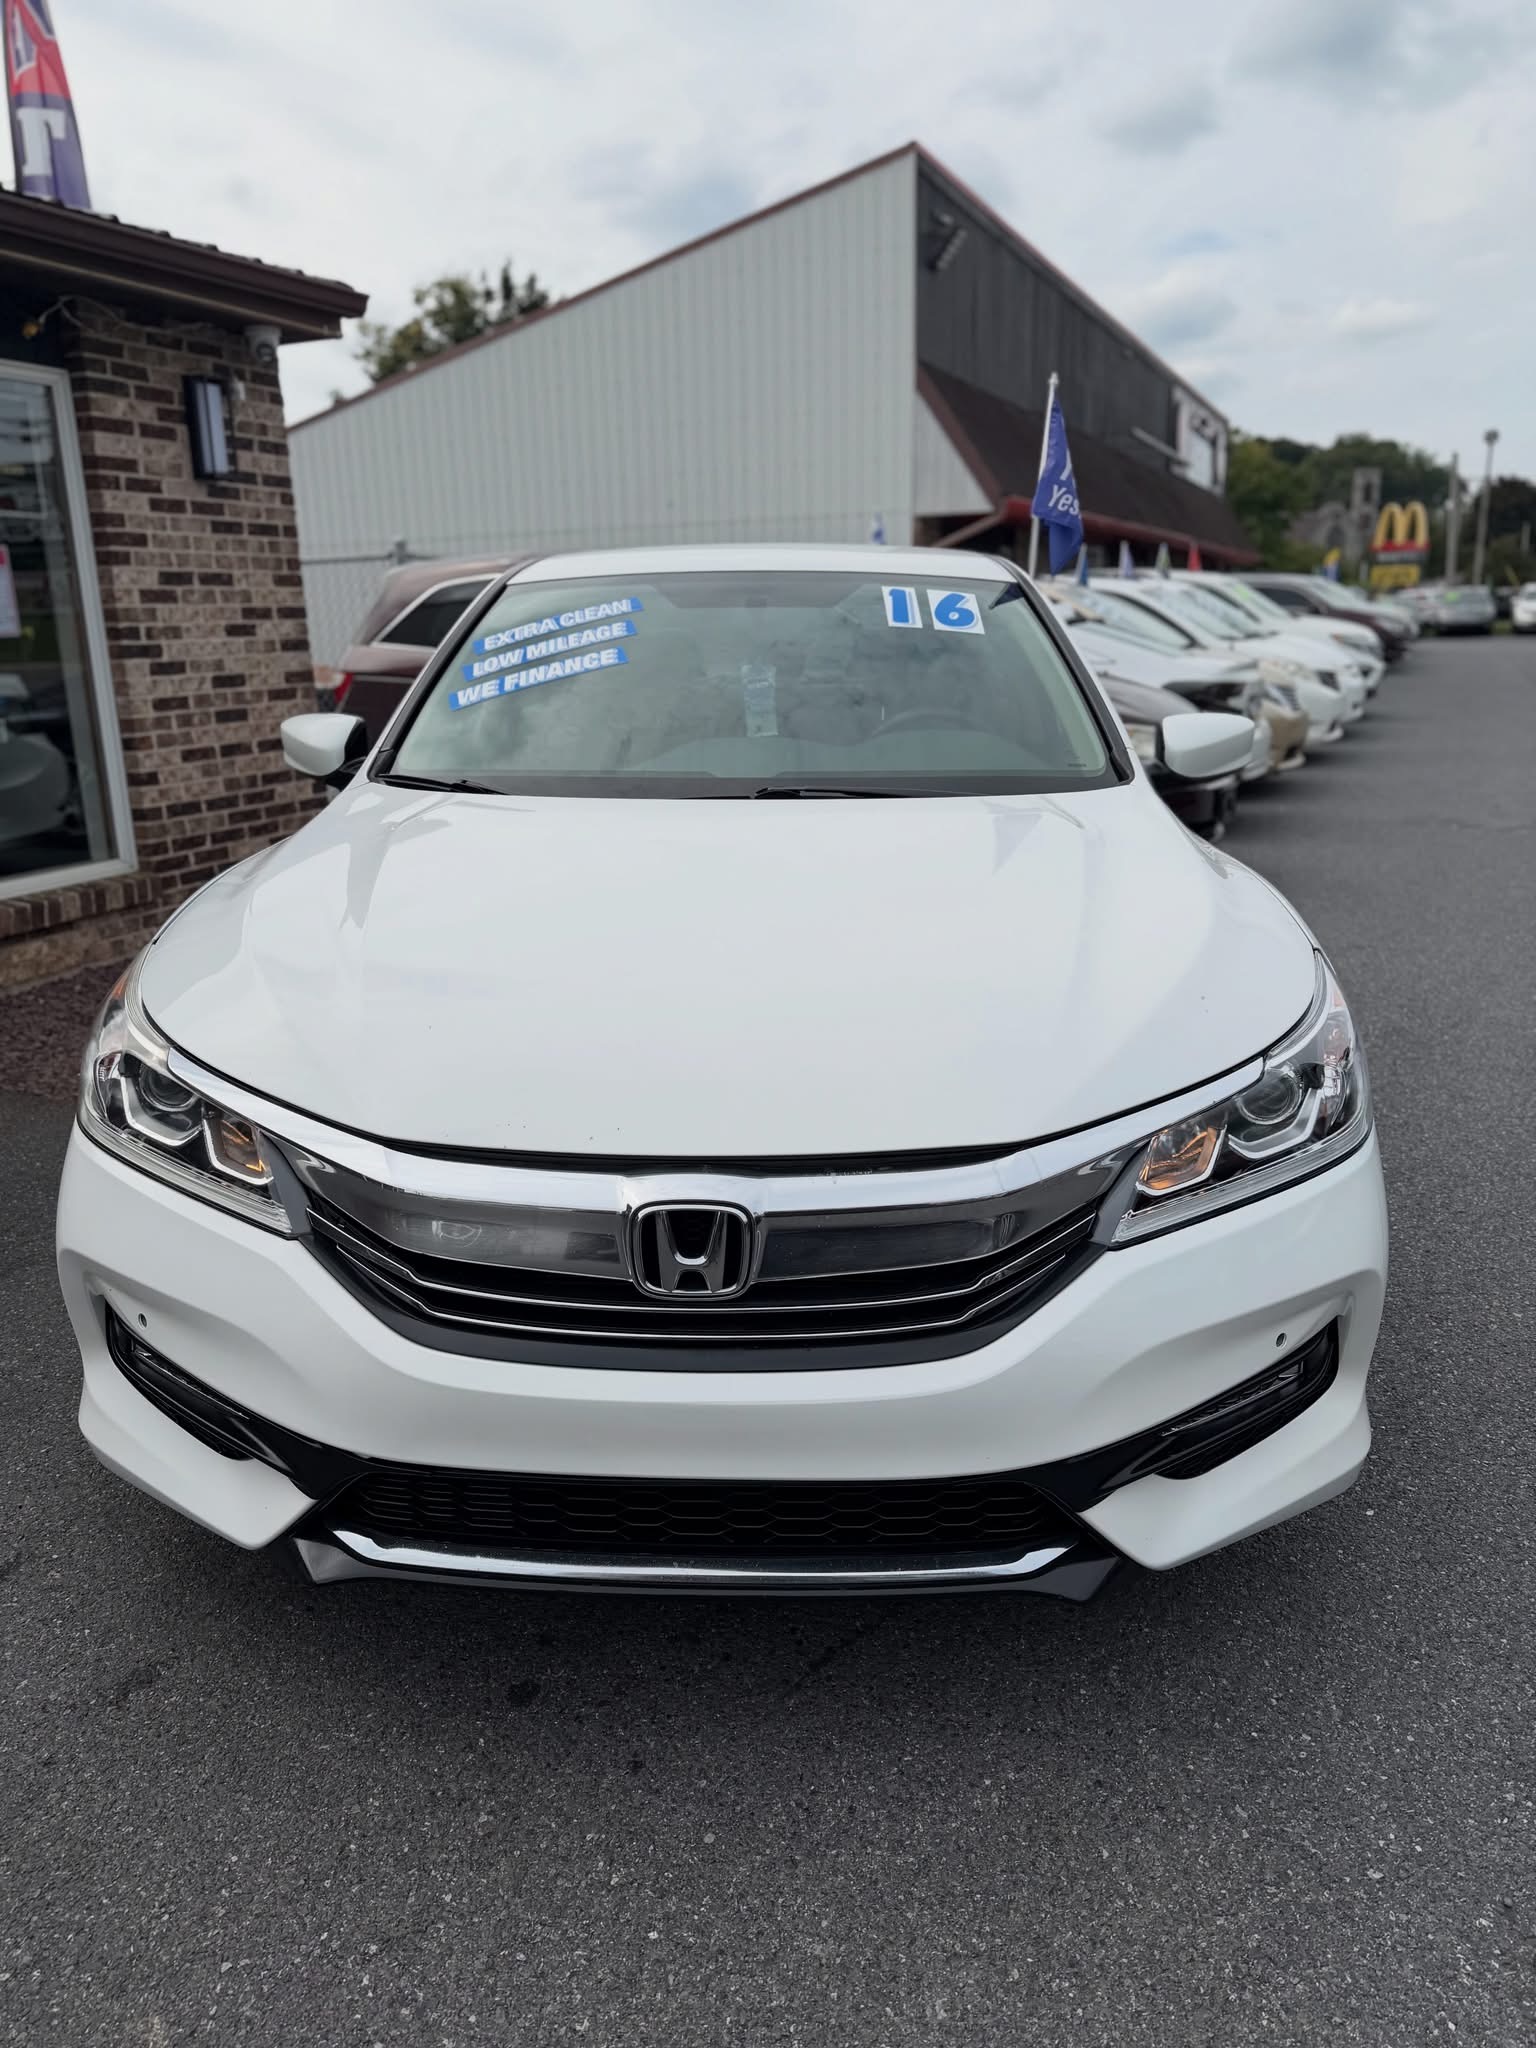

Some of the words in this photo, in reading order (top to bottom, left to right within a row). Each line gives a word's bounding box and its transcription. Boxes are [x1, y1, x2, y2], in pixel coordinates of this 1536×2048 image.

[483, 617, 559, 651] EXTRA
[559, 598, 631, 627] CLEAN
[886, 587, 978, 630] 16
[472, 648, 525, 678] LOW
[526, 621, 628, 661] MILEAGE
[456, 680, 501, 707] WE
[503, 648, 620, 692] FINANCE
